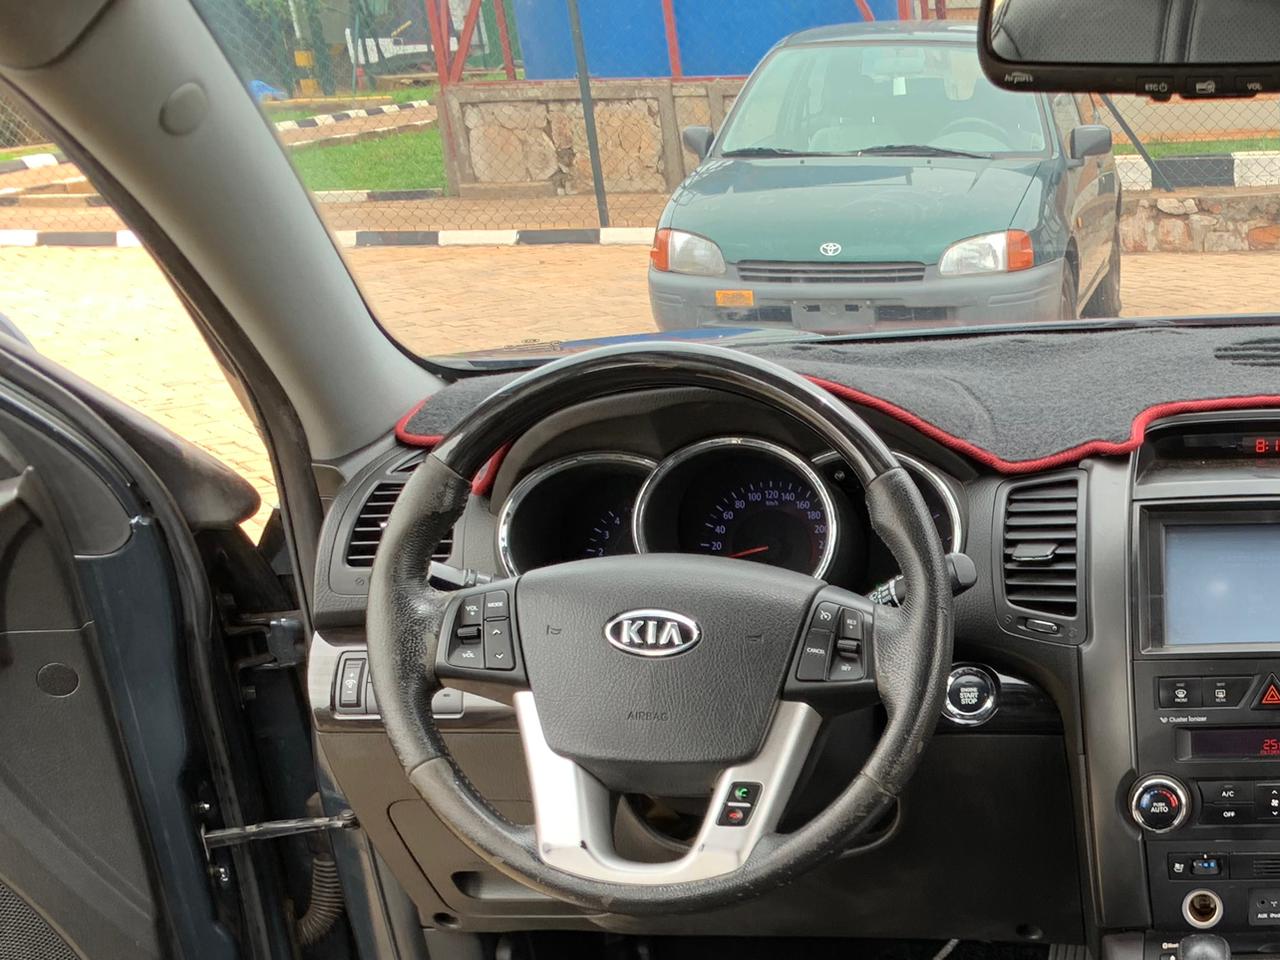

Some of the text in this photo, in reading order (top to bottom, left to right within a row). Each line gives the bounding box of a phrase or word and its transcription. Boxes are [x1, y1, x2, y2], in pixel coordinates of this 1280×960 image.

[748, 493, 762, 501] 100
[764, 490, 779, 499] 120
[781, 492, 796, 501] 140
[735, 500, 746, 509] 80
[796, 500, 810, 509] 160
[723, 511, 734, 520] 60
[807, 511, 821, 520] 180
[715, 525, 726, 534] 40
[711, 542, 722, 551] 20
[621, 620, 684, 645] KIA
[626, 711, 669, 722] AIRBAG
[1221, 790, 1235, 798] A/C
[1222, 810, 1236, 818] OFF
